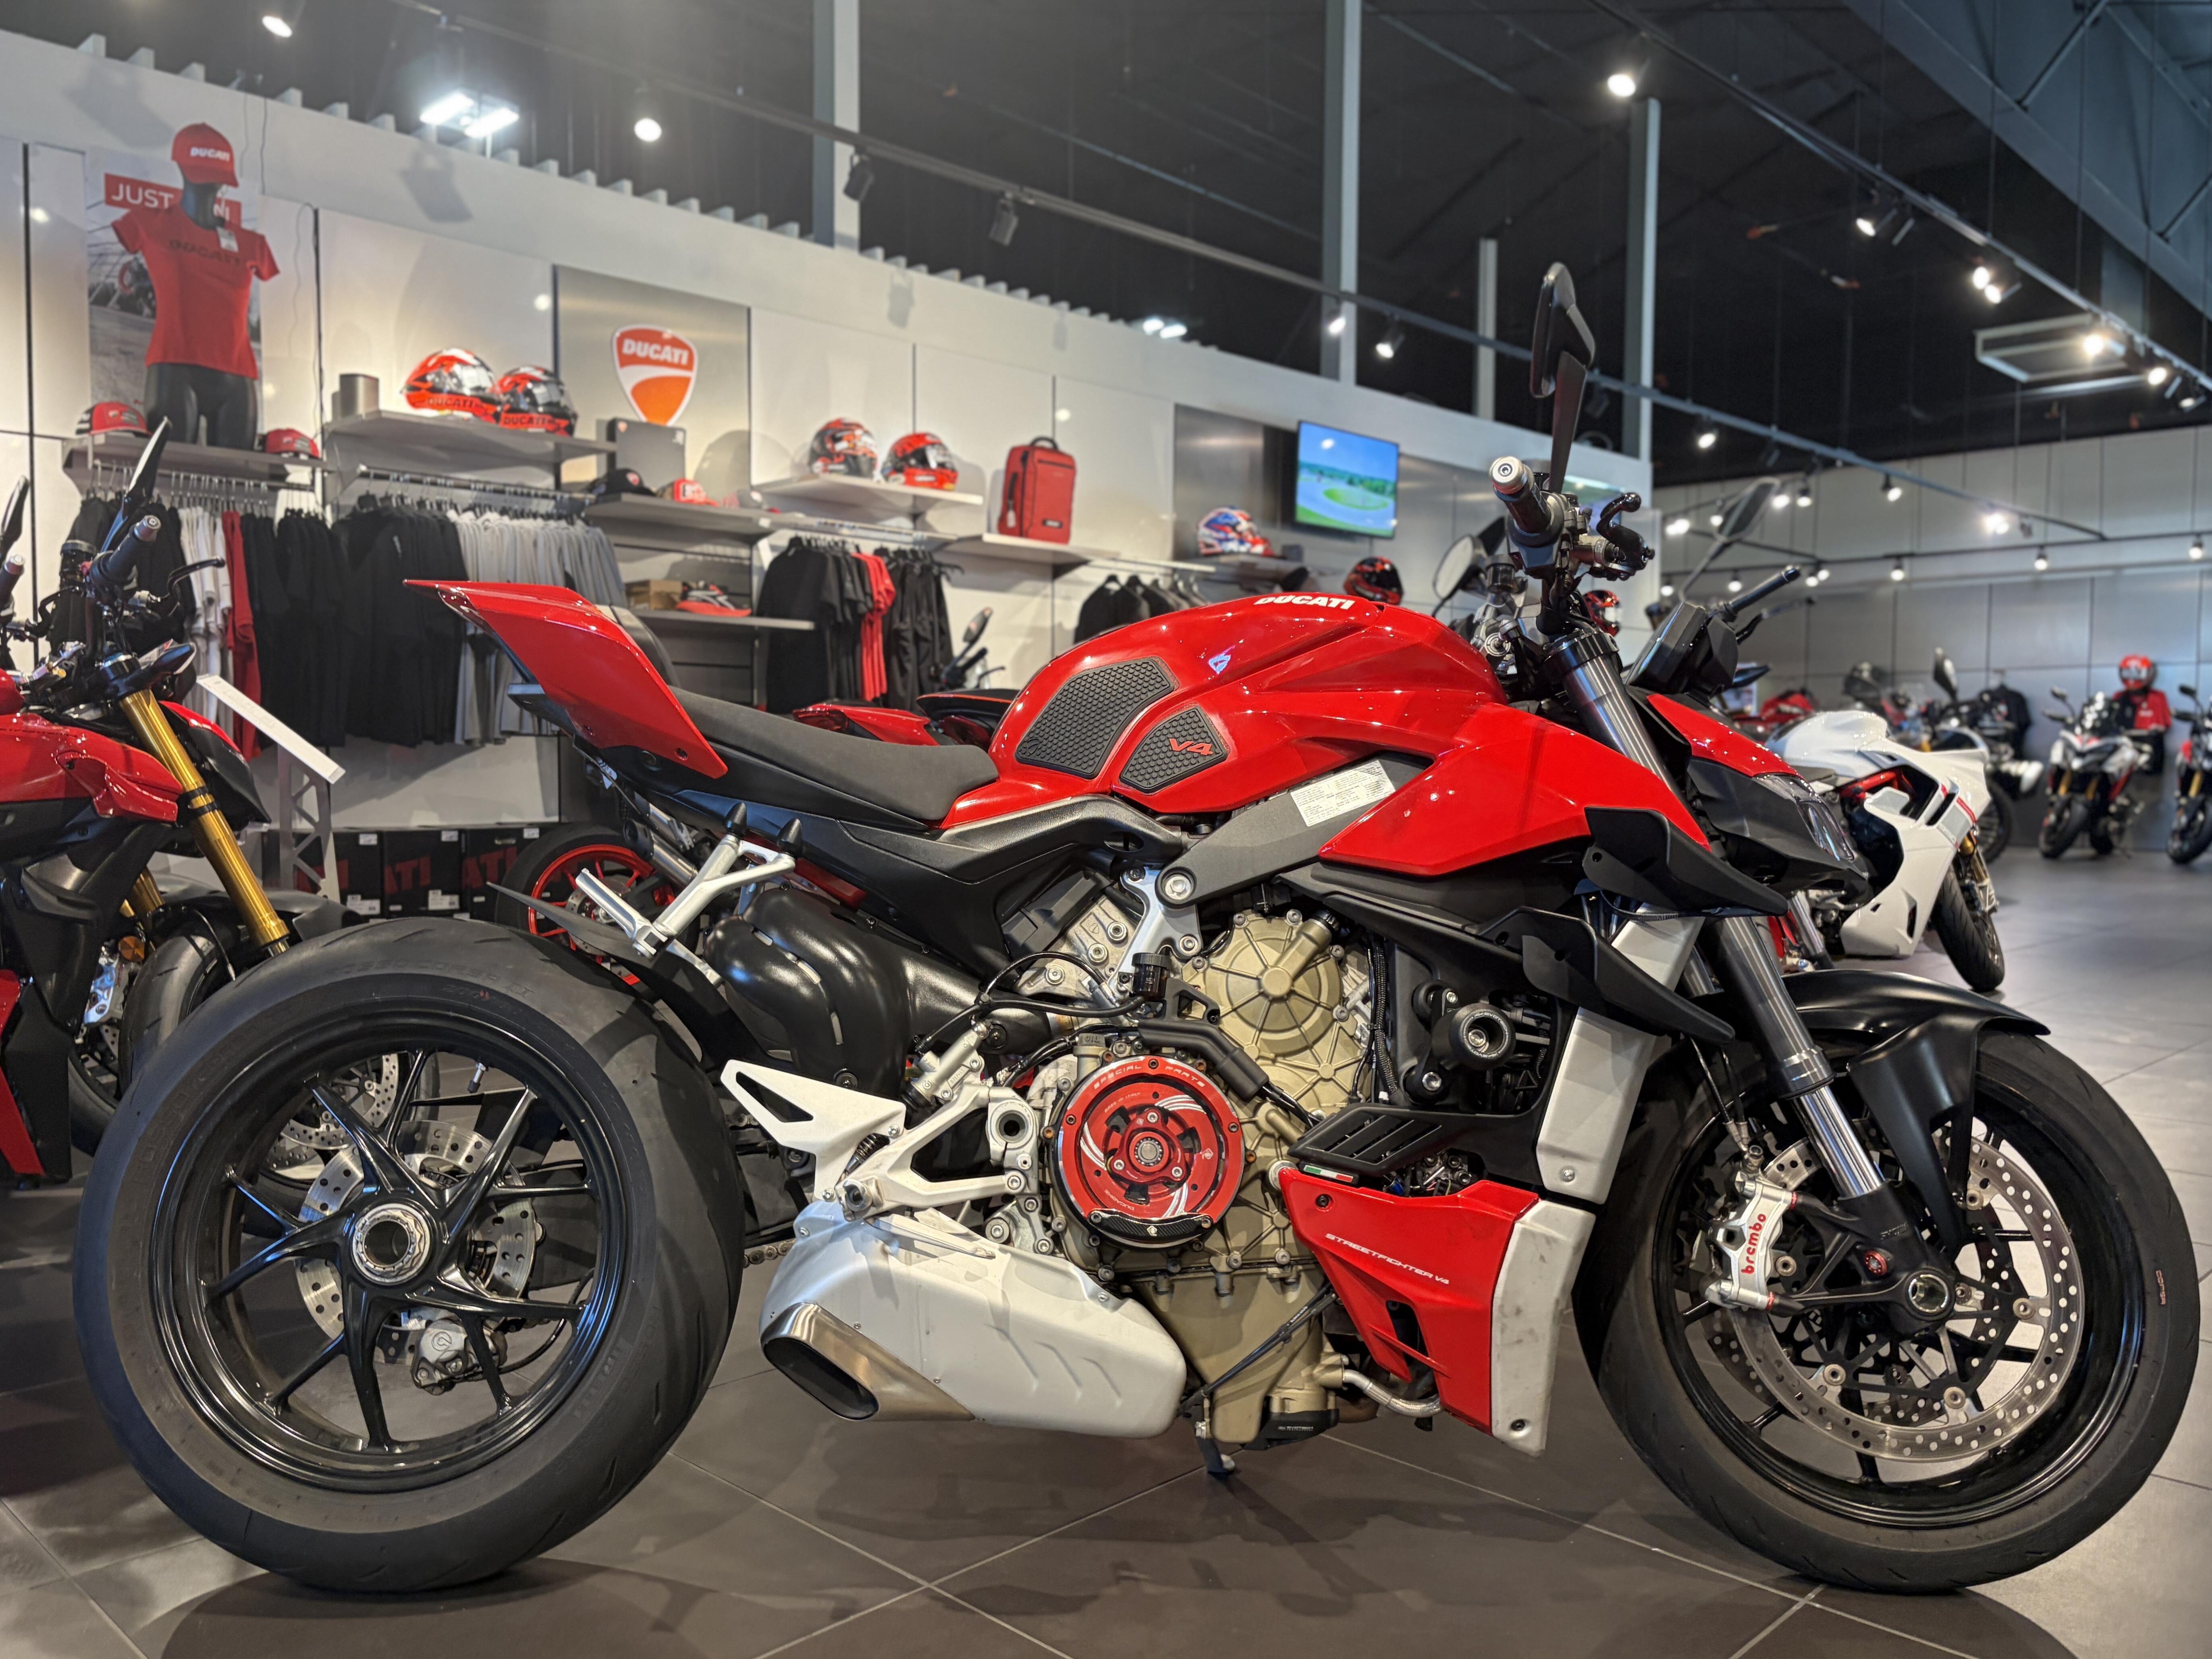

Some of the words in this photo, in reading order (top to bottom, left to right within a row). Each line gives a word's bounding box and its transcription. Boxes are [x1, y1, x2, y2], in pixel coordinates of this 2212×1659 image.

[190, 147, 231, 162] DUCATI
[111, 183, 174, 210] JUST
[622, 338, 689, 366] DUCATI
[503, 416, 546, 426] DUCATI
[1253, 594, 1356, 610] DUCATI
[1169, 738, 1214, 756] V4
[1093, 1065, 1142, 1090] SPECIAL
[1165, 1065, 1206, 1088] PARTS
[1741, 1213, 1766, 1274] brembo
[1325, 1233, 1433, 1279] STREETFIGHTER
[1434, 1275, 1450, 1285] V4
